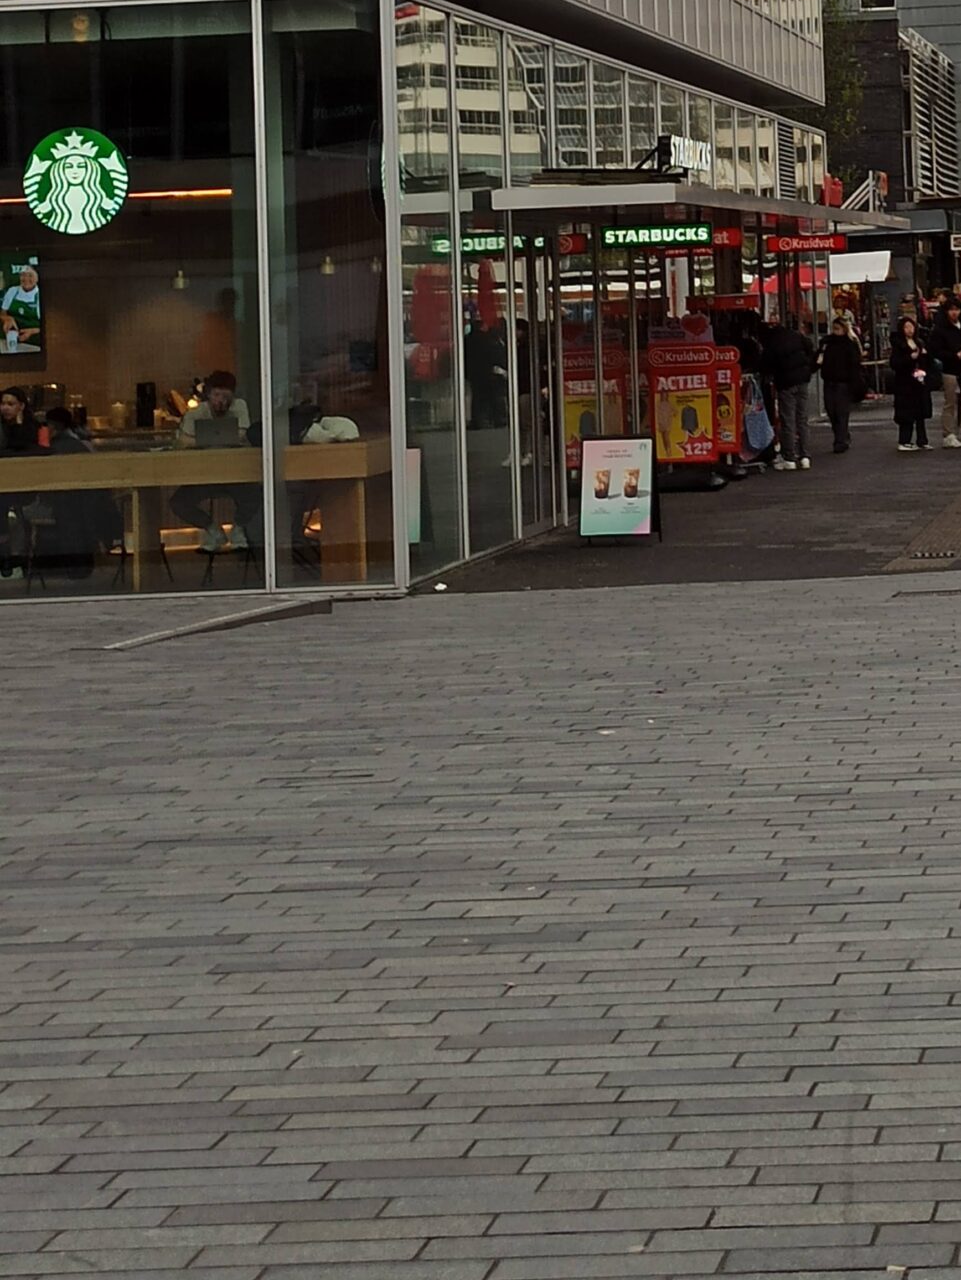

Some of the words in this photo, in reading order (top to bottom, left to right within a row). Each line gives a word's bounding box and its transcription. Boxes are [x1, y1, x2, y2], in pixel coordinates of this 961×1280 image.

[605, 226, 708, 245] STARBUCKS
[791, 237, 835, 250] Kruidvat
[664, 348, 710, 362] Kruidvat
[657, 374, 708, 391] ACTIE!
